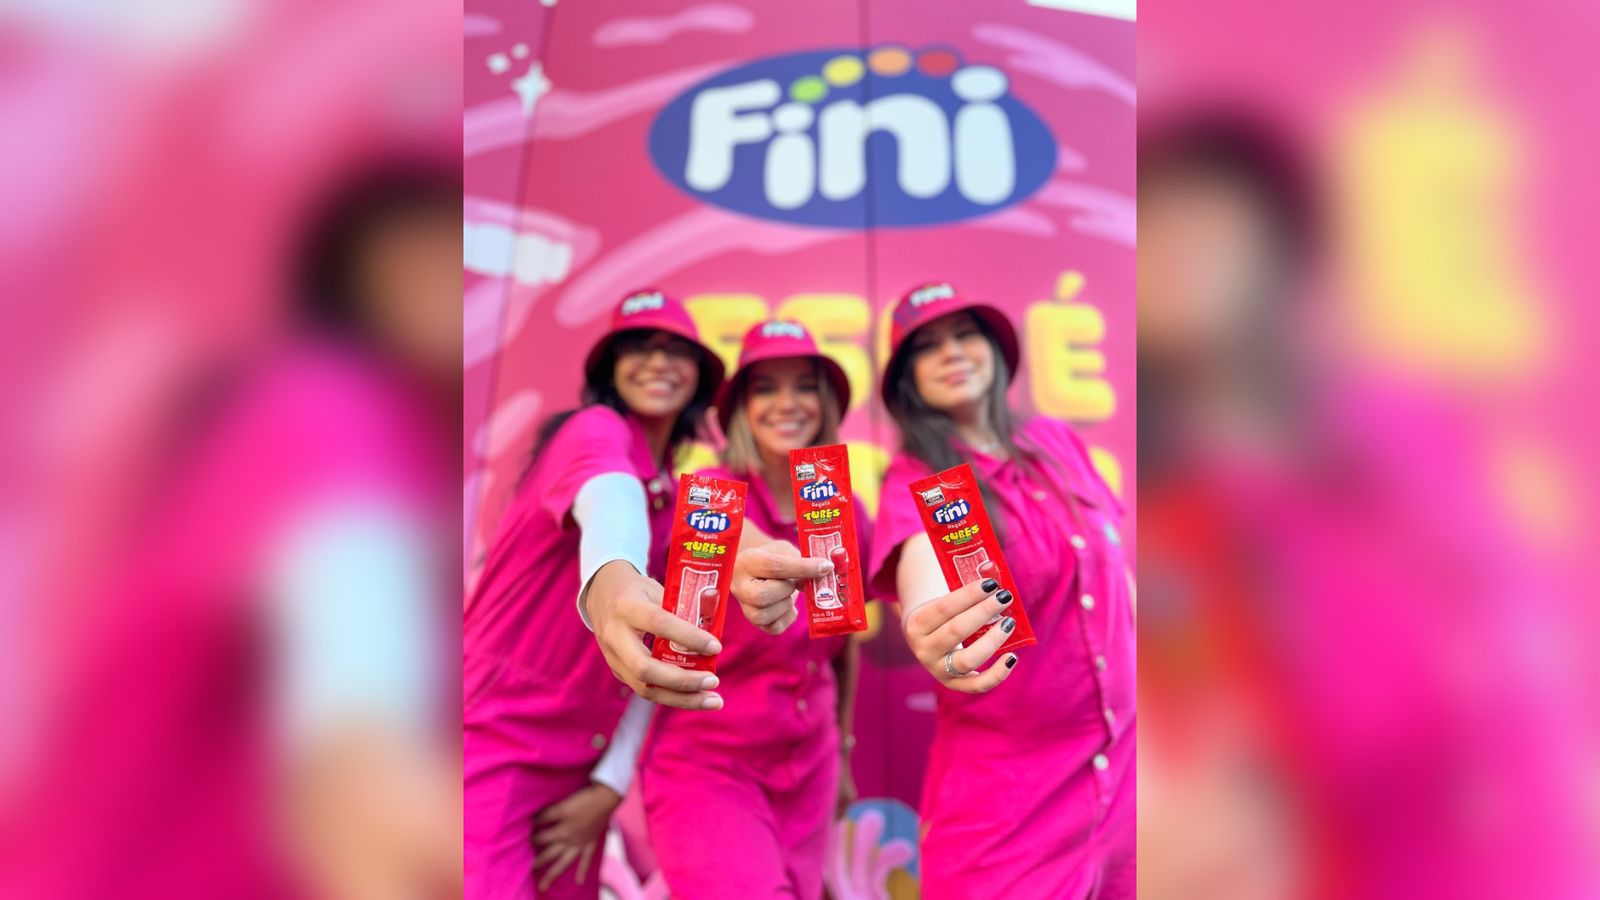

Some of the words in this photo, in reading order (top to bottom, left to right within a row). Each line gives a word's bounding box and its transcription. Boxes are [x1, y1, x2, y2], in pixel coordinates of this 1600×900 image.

[685, 65, 1017, 210] Fini
[803, 480, 835, 500] Fini
[803, 508, 841, 521] TUBES
[935, 498, 969, 523] Fini
[689, 512, 728, 531] Fini
[942, 524, 980, 543] TUBES
[683, 541, 727, 555] TUBES
